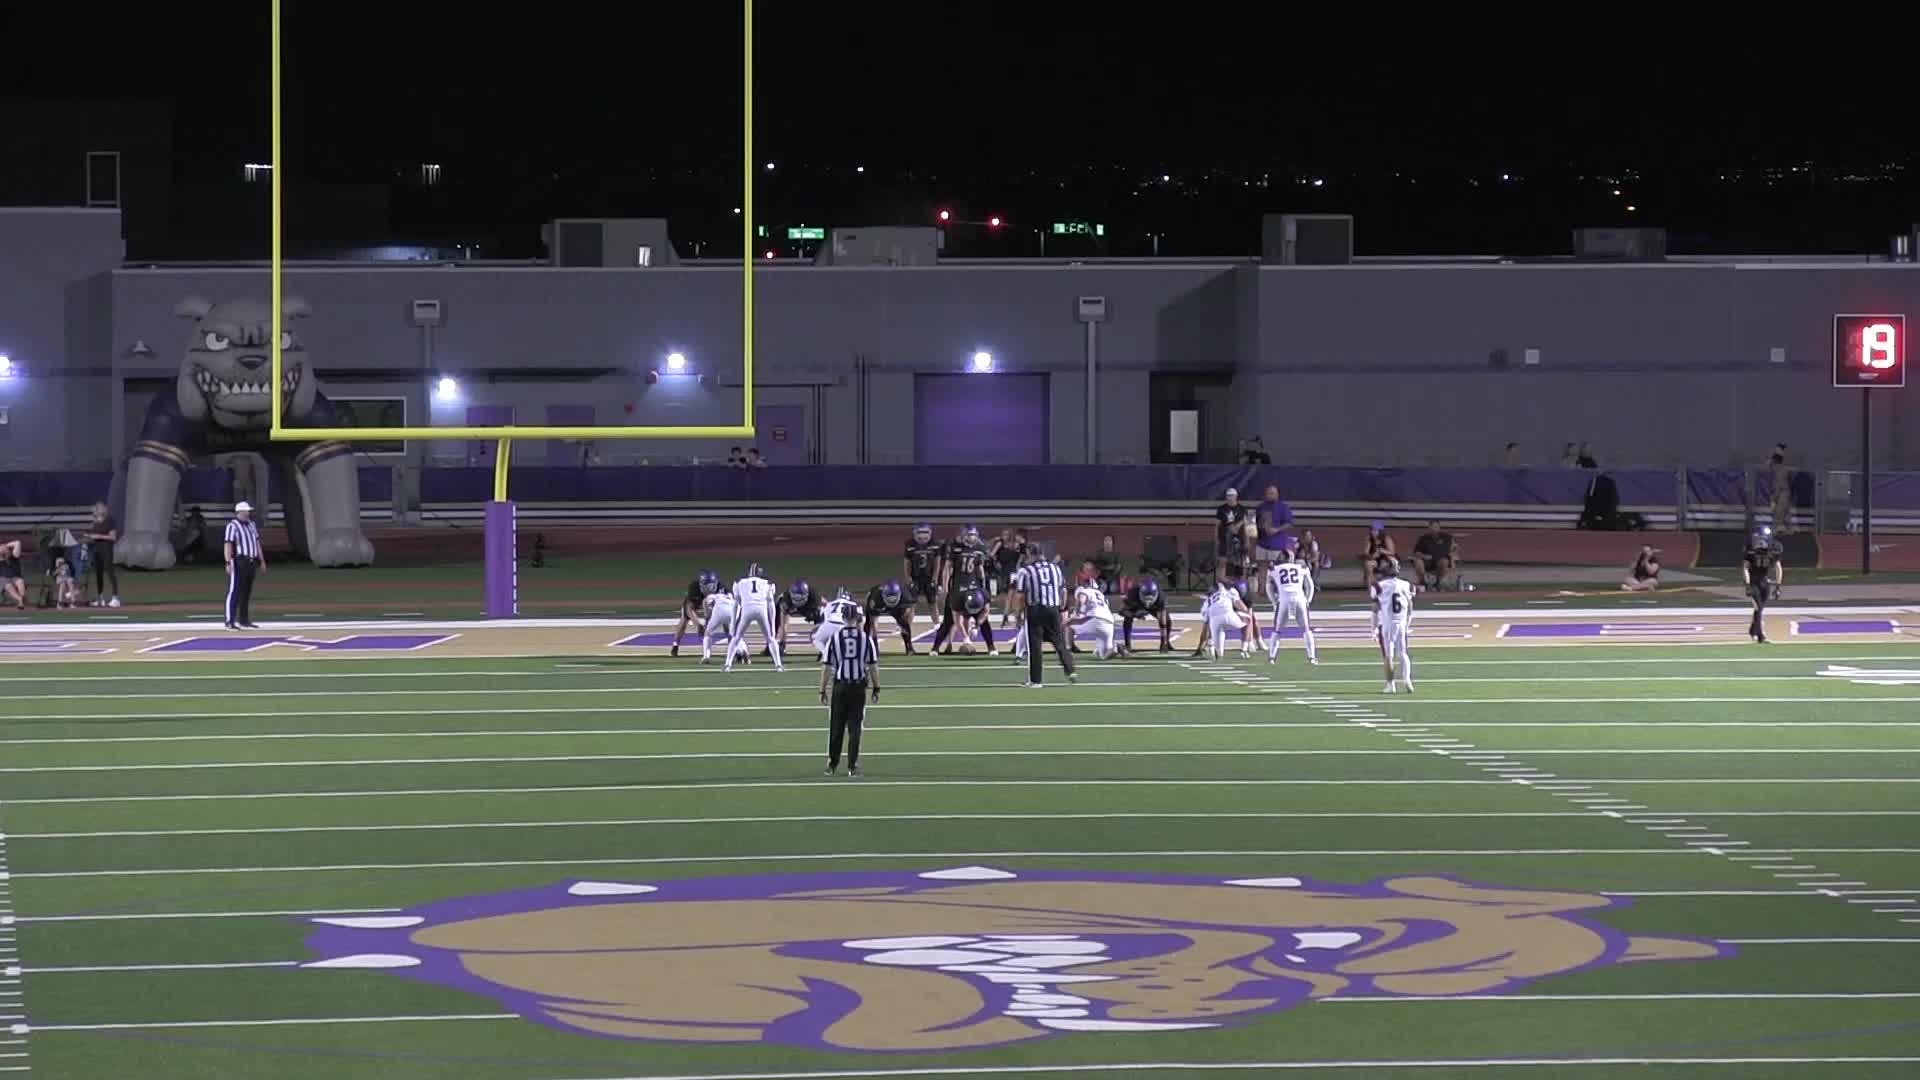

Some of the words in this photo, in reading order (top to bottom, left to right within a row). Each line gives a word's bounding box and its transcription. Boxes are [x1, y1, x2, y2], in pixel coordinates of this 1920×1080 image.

[1862, 324, 1895, 368] 19
[919, 553, 928, 568] 3
[961, 557, 975, 573] 16
[1279, 567, 1299, 585] 22
[752, 580, 758, 593] 1
[1391, 592, 1402, 614] 6
[844, 638, 857, 657] B
